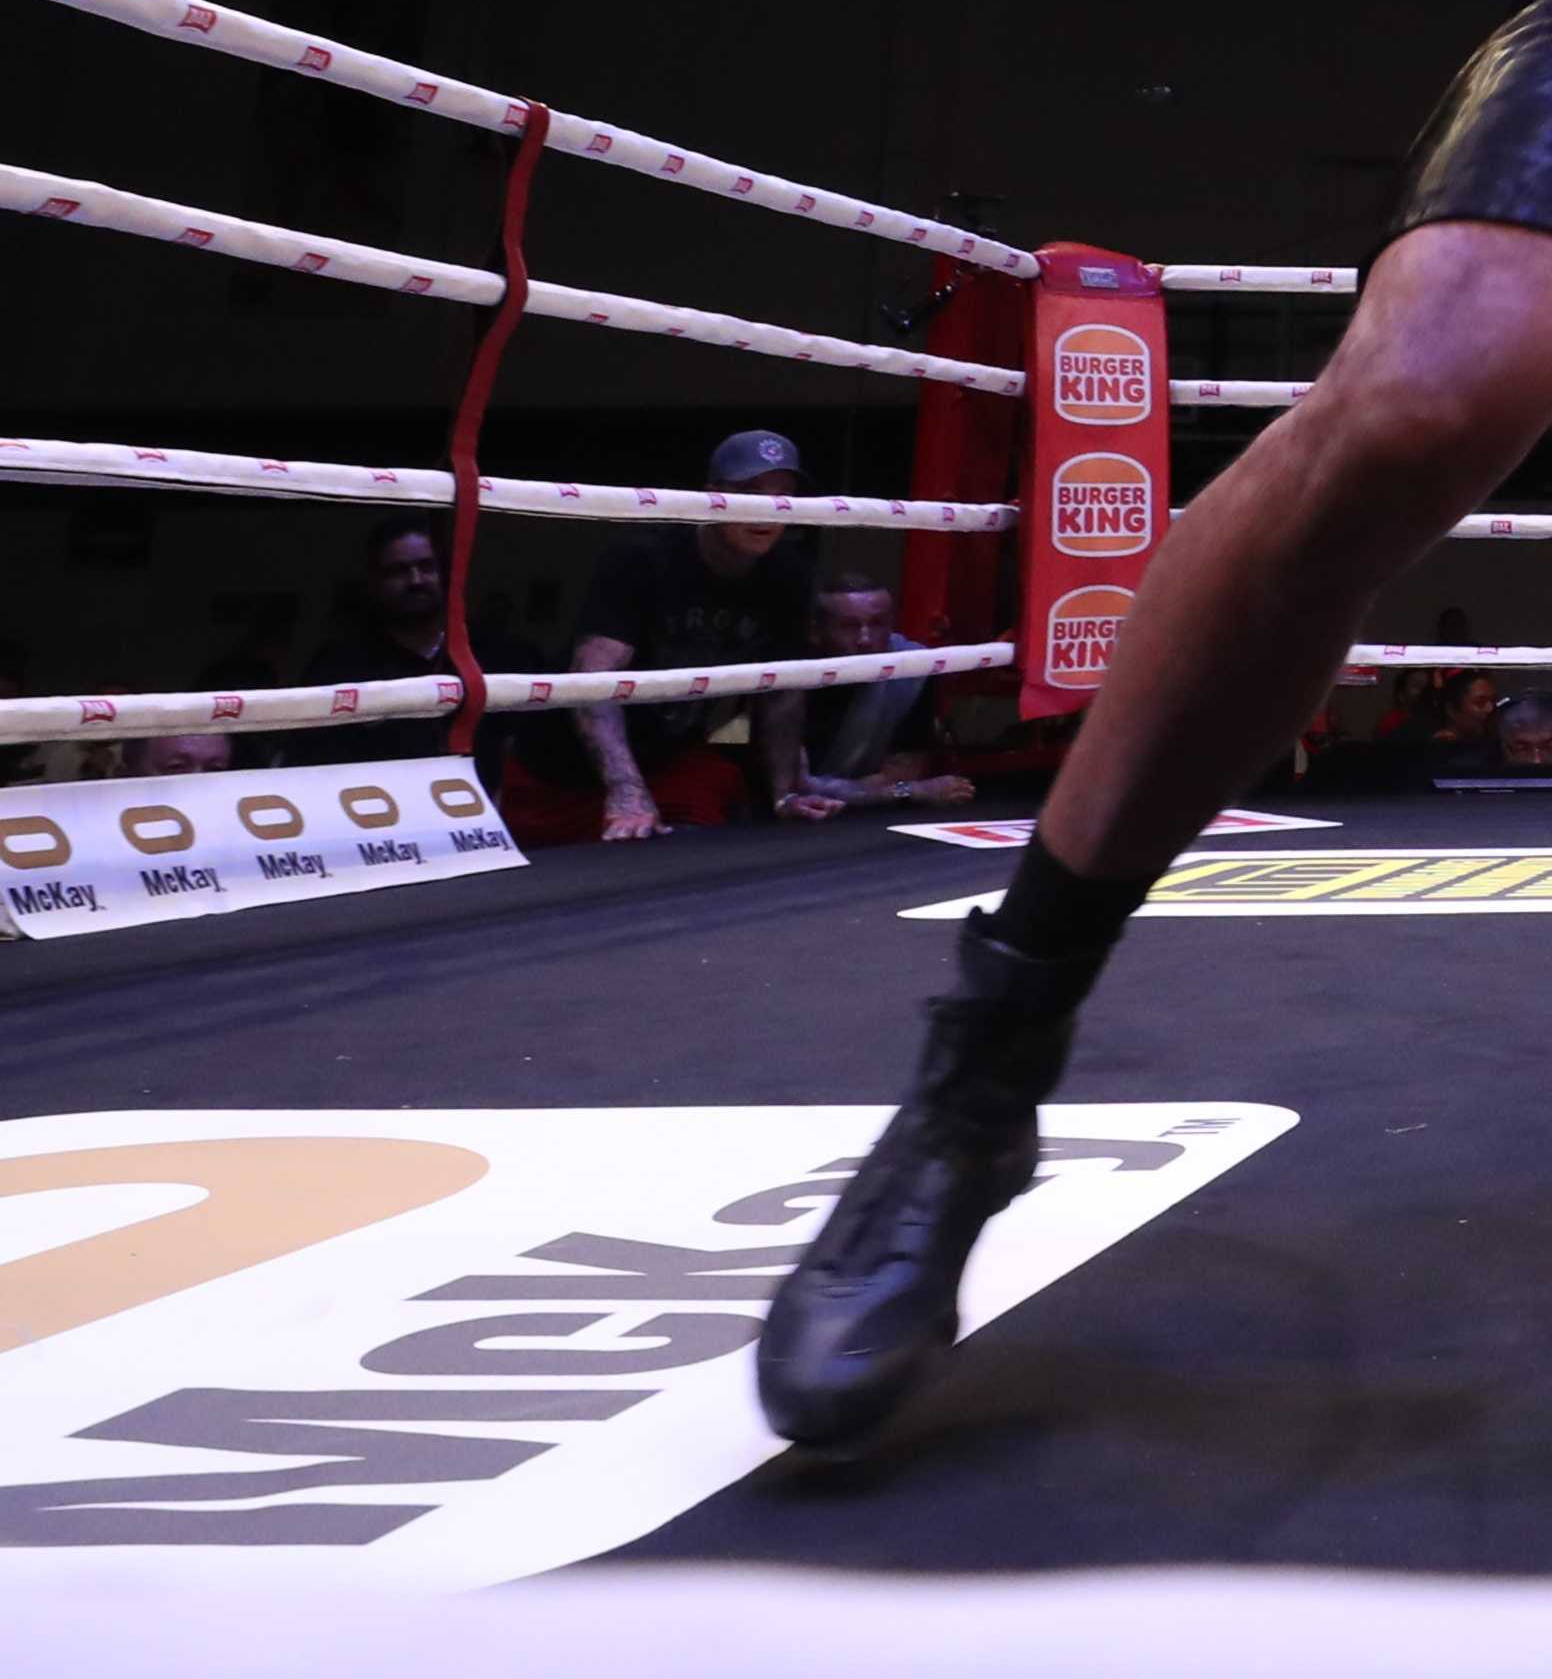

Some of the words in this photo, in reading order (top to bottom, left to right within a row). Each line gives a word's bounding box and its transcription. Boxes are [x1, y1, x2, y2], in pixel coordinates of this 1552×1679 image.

[1060, 355, 1145, 376] BURGER
[1060, 374, 1146, 403] KING
[1058, 486, 1146, 505] BURGER
[1057, 506, 1146, 534] KING
[1053, 619, 1118, 640] BURG
[1051, 640, 1114, 669] KIN
[356, 838, 421, 867] McKay
[448, 826, 509, 852] McKay
[255, 850, 327, 879] McKay
[139, 864, 220, 897] McKay
[9, 881, 97, 916] McKay
